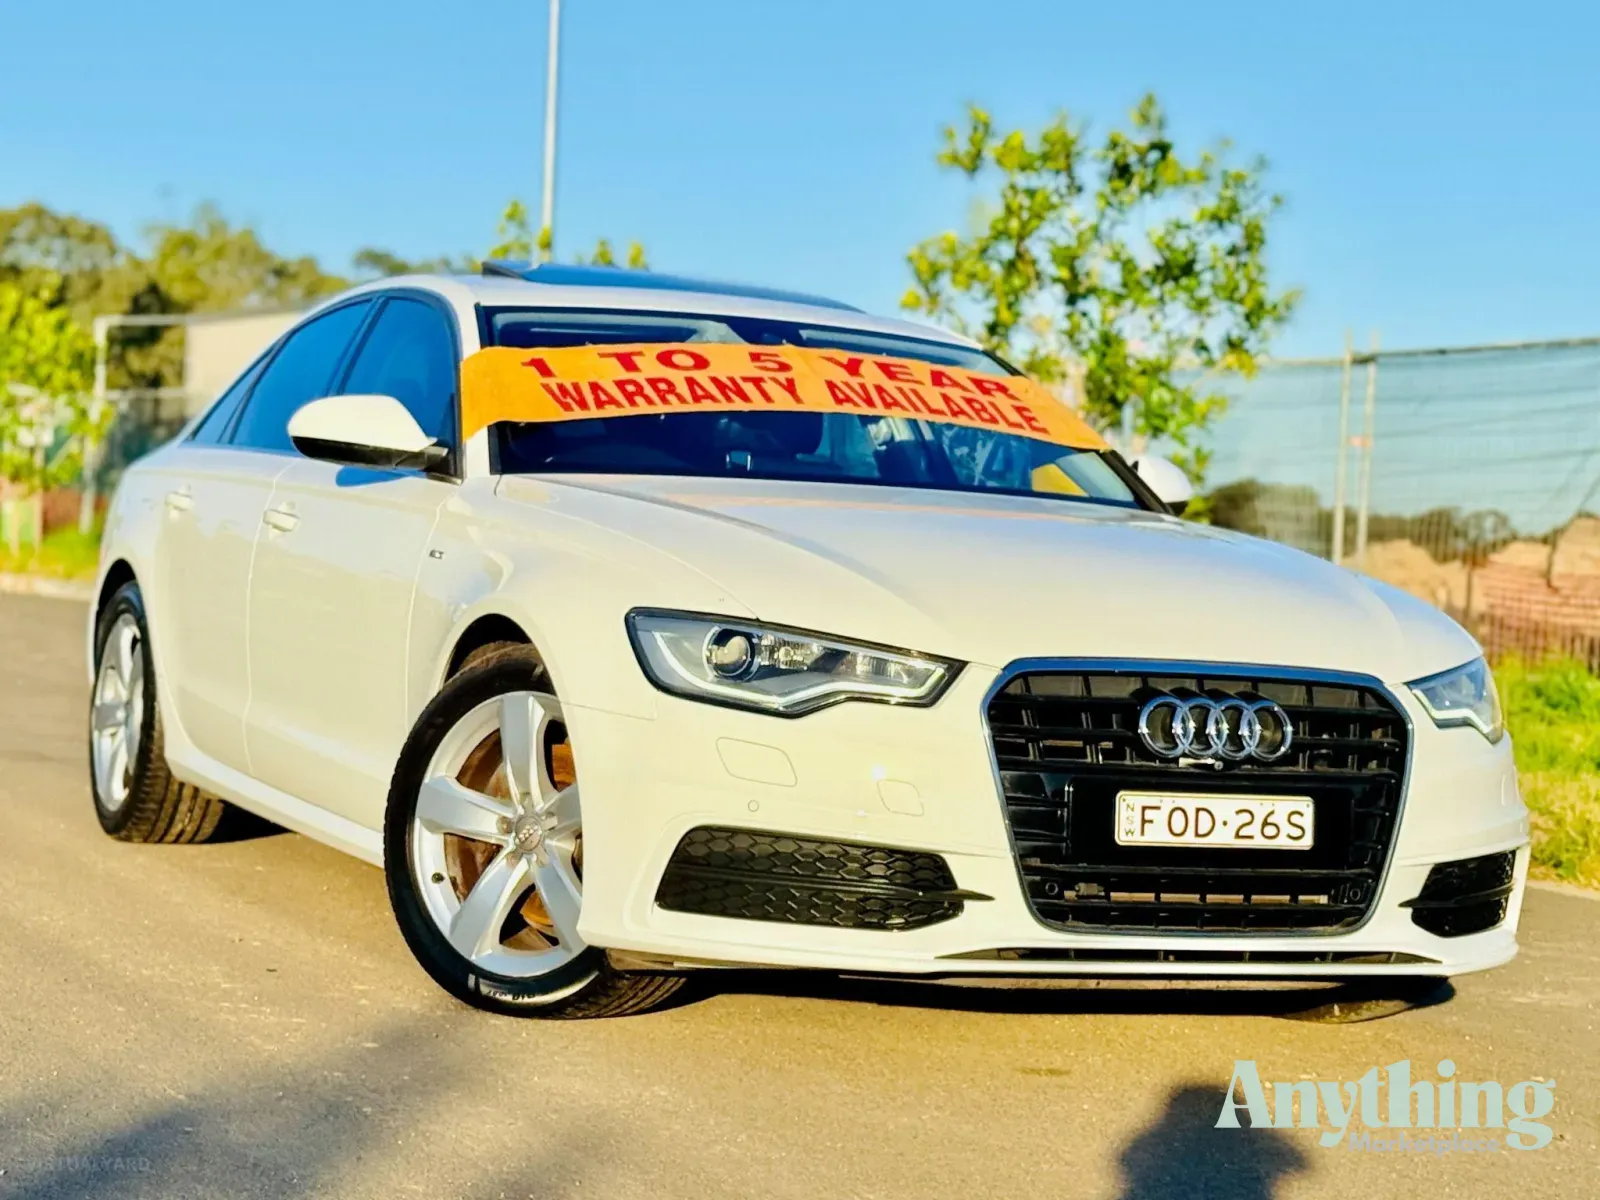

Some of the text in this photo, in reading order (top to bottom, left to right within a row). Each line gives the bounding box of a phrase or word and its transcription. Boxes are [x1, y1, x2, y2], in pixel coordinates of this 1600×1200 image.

[522, 350, 1020, 401] 1 TO 5 YEAR
[541, 376, 1049, 434] WARRANTY AVAILABLE
